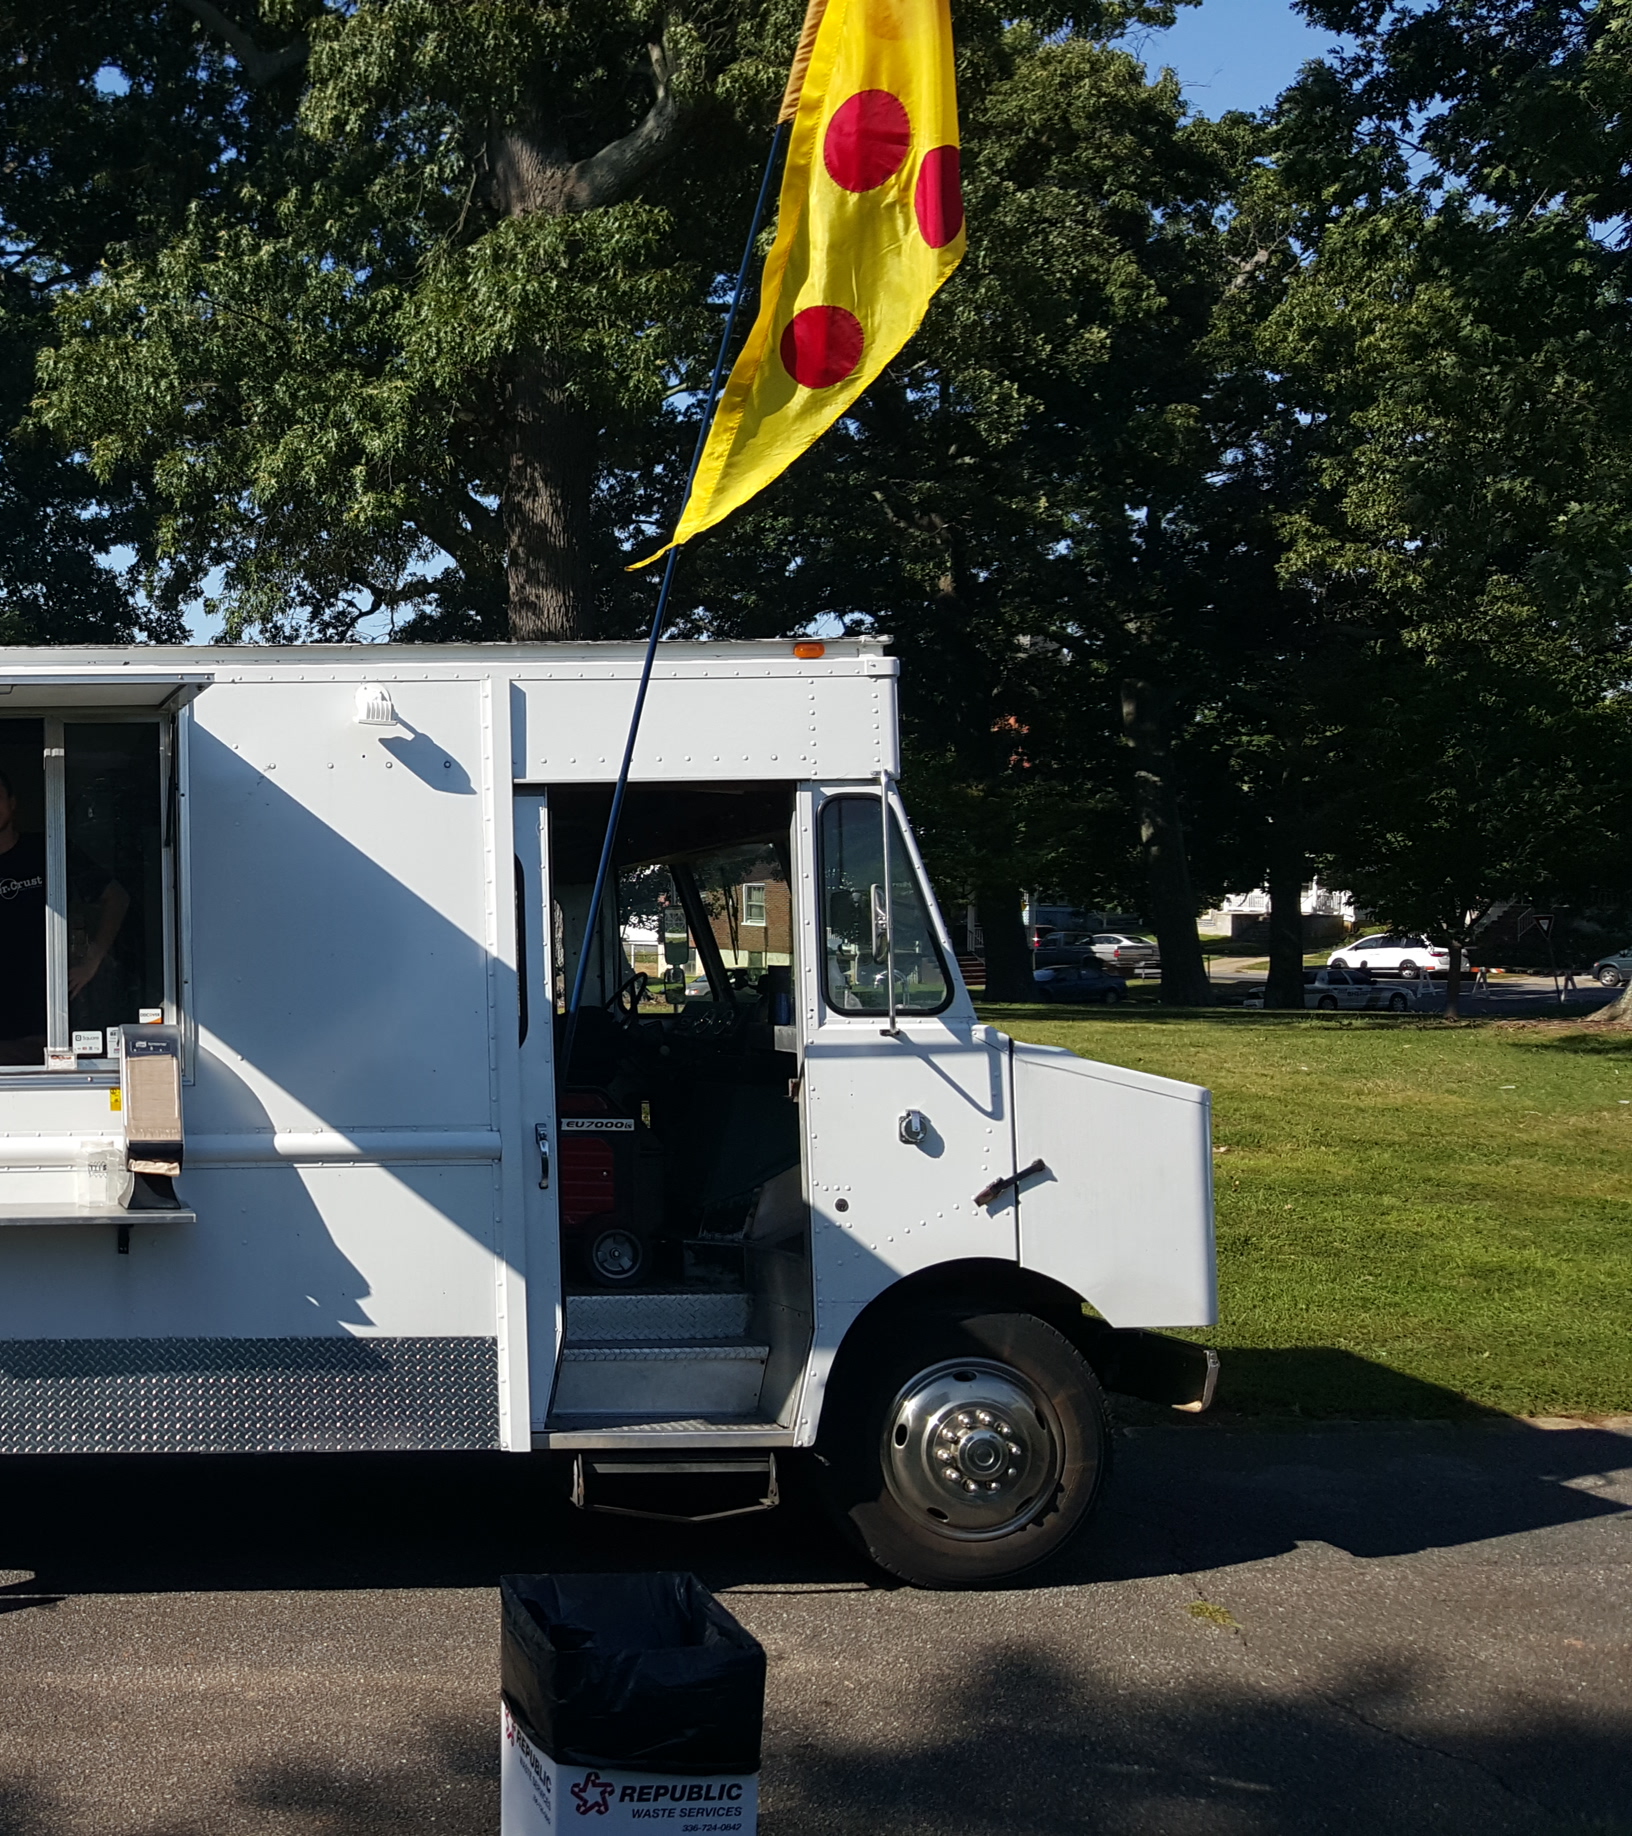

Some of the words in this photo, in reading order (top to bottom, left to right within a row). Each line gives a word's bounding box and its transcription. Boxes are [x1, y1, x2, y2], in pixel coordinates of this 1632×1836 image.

[10, 876, 43, 890] Crust
[516, 1728, 552, 1794] REPUBLIC
[619, 1782, 743, 1803] REPUBLIC
[632, 1808, 677, 1819] WASTE
[679, 1806, 742, 1818] SERVICES
